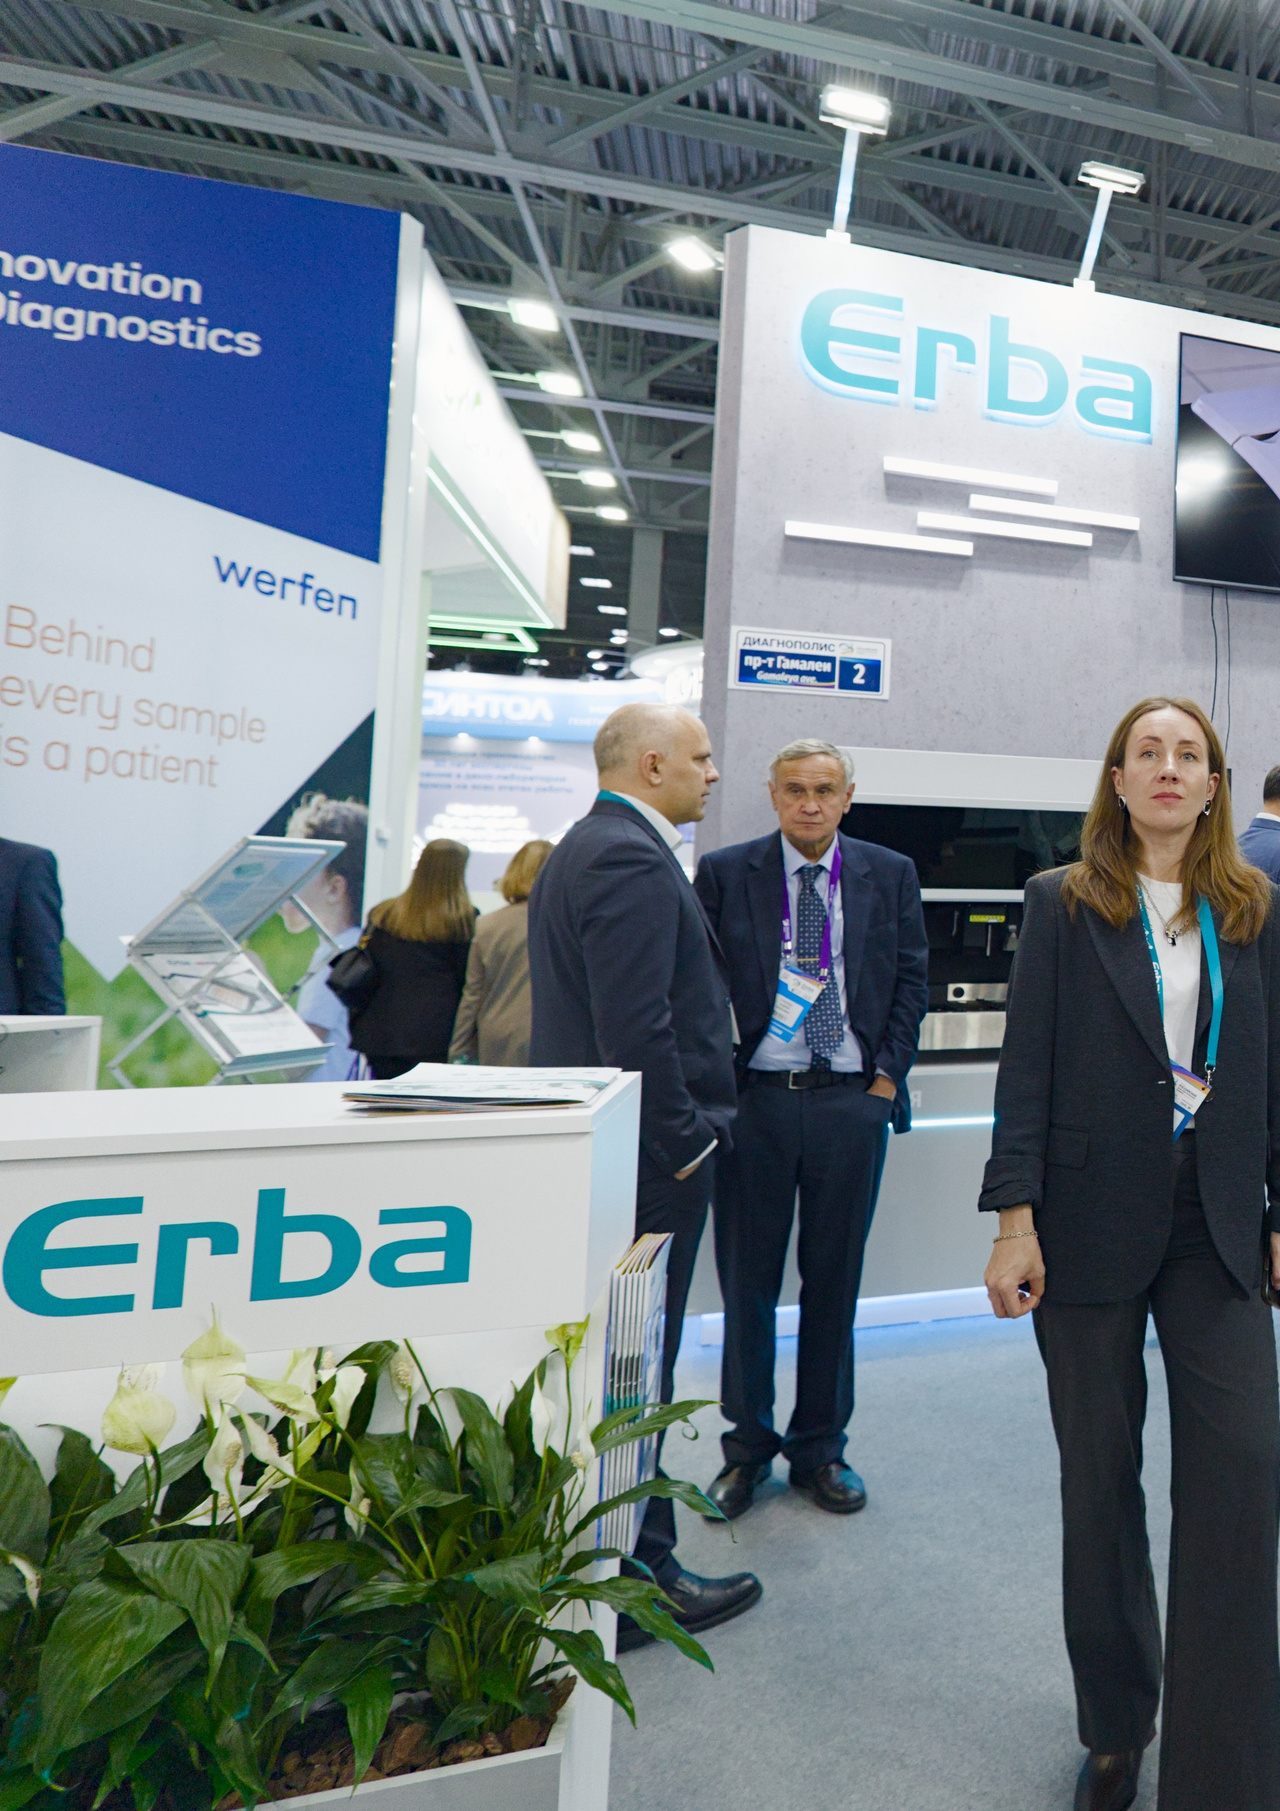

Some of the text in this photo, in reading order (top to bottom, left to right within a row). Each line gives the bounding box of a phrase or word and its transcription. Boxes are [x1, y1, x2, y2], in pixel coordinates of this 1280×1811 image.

[800, 288, 1152, 440] Erba
[213, 554, 358, 620] werfen
[5, 604, 156, 673] Behind
[743, 637, 835, 652] ДИАГНОПОЛИС
[744, 655, 775, 670] пр-т
[852, 663, 866, 685] 2
[0, 676, 266, 746] every sample
[0, 722, 219, 788] s a patient
[3, 1188, 472, 1317] Erba
